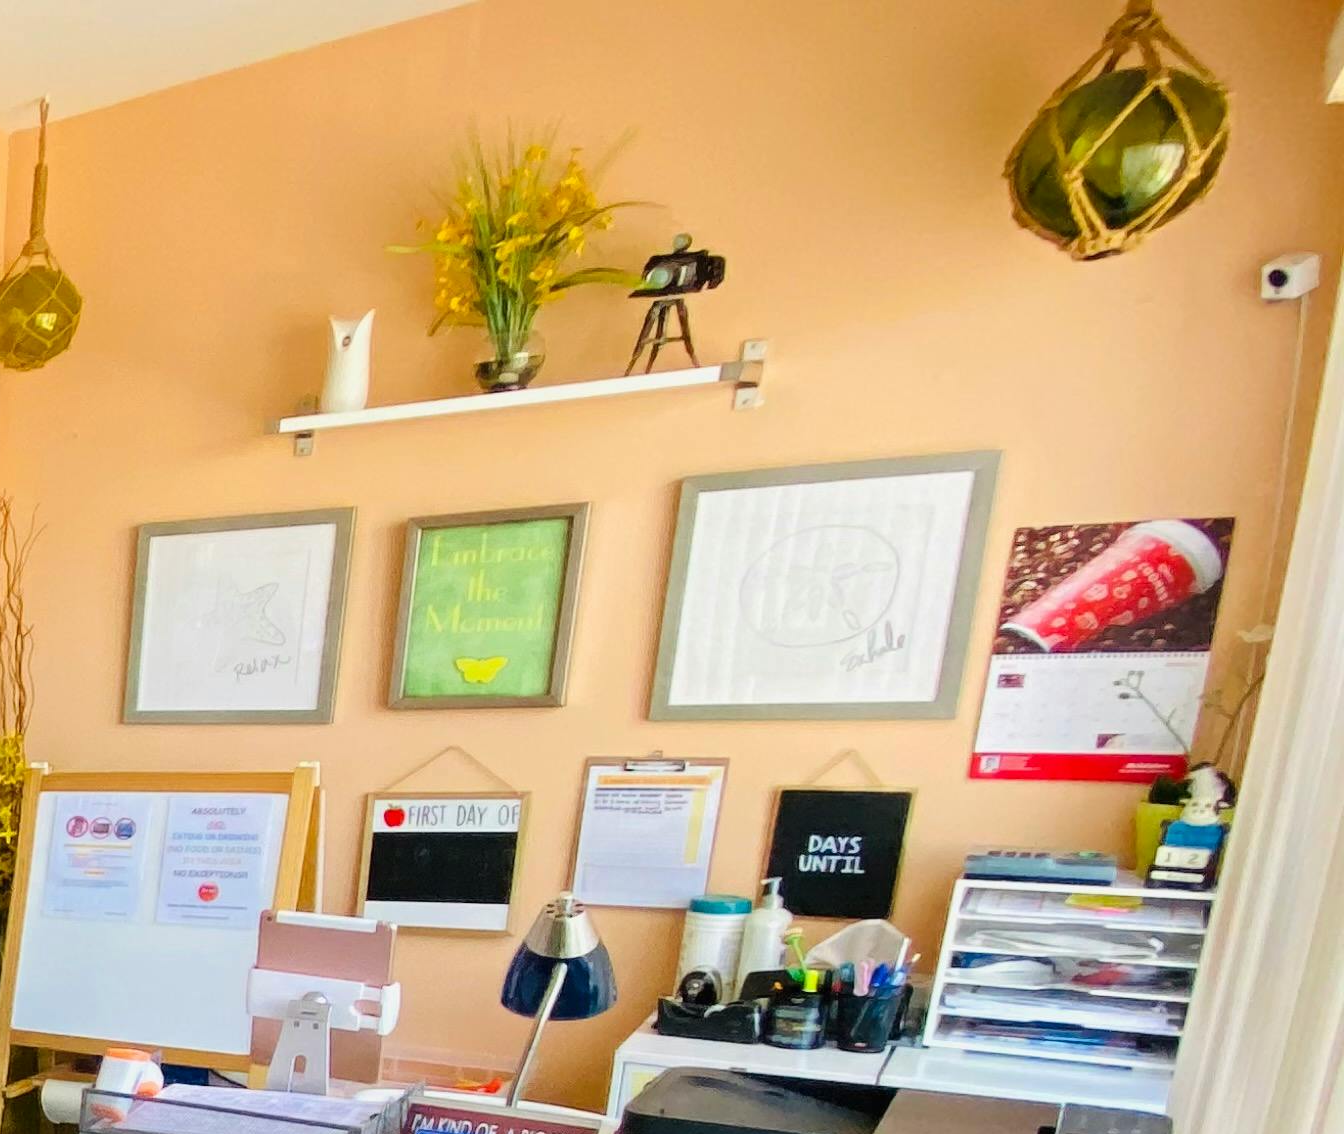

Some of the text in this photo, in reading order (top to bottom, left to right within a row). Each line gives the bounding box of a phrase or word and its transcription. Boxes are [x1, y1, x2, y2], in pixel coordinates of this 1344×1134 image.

[430, 533, 554, 567] Embrace
[426, 603, 543, 633] Moment
[408, 804, 520, 827] FIRST DAY OF
[807, 835, 862, 854] DAYS
[799, 855, 865, 875] UNTIL
